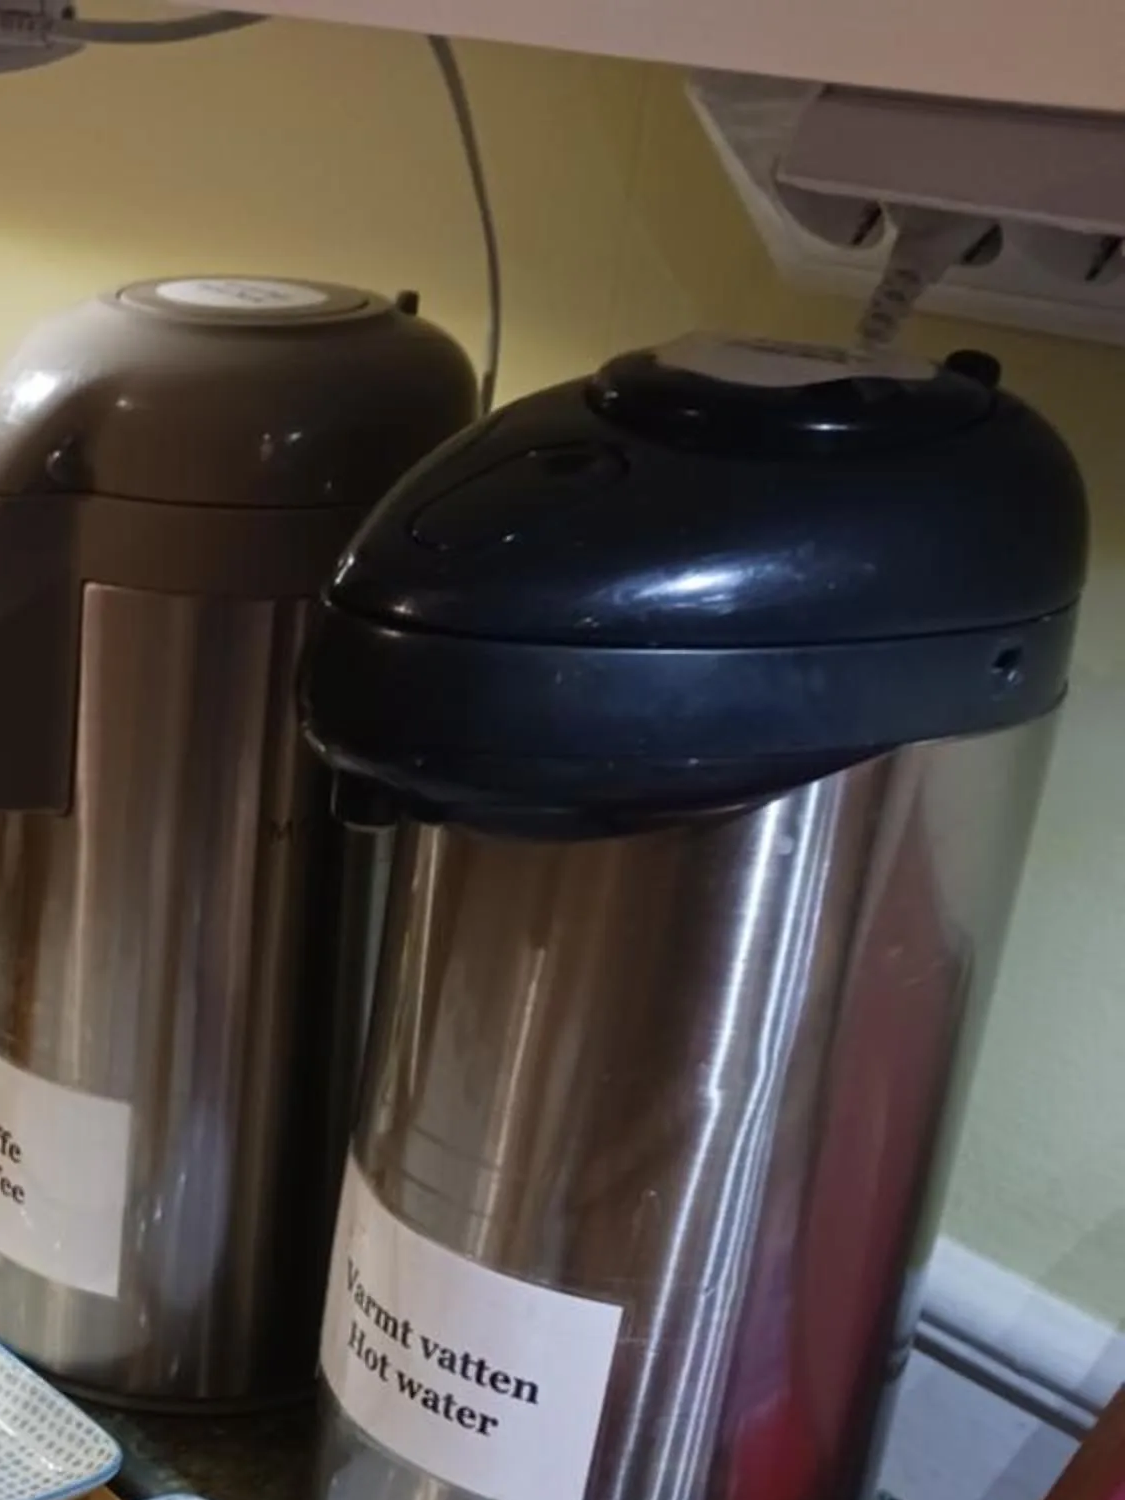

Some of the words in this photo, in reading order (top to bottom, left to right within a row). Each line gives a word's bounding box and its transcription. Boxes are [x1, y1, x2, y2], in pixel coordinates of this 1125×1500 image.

[347, 1257, 414, 1349] Varmt
[420, 1334, 539, 1405] vatten
[347, 1321, 391, 1383] Hot
[395, 1366, 499, 1437] water
